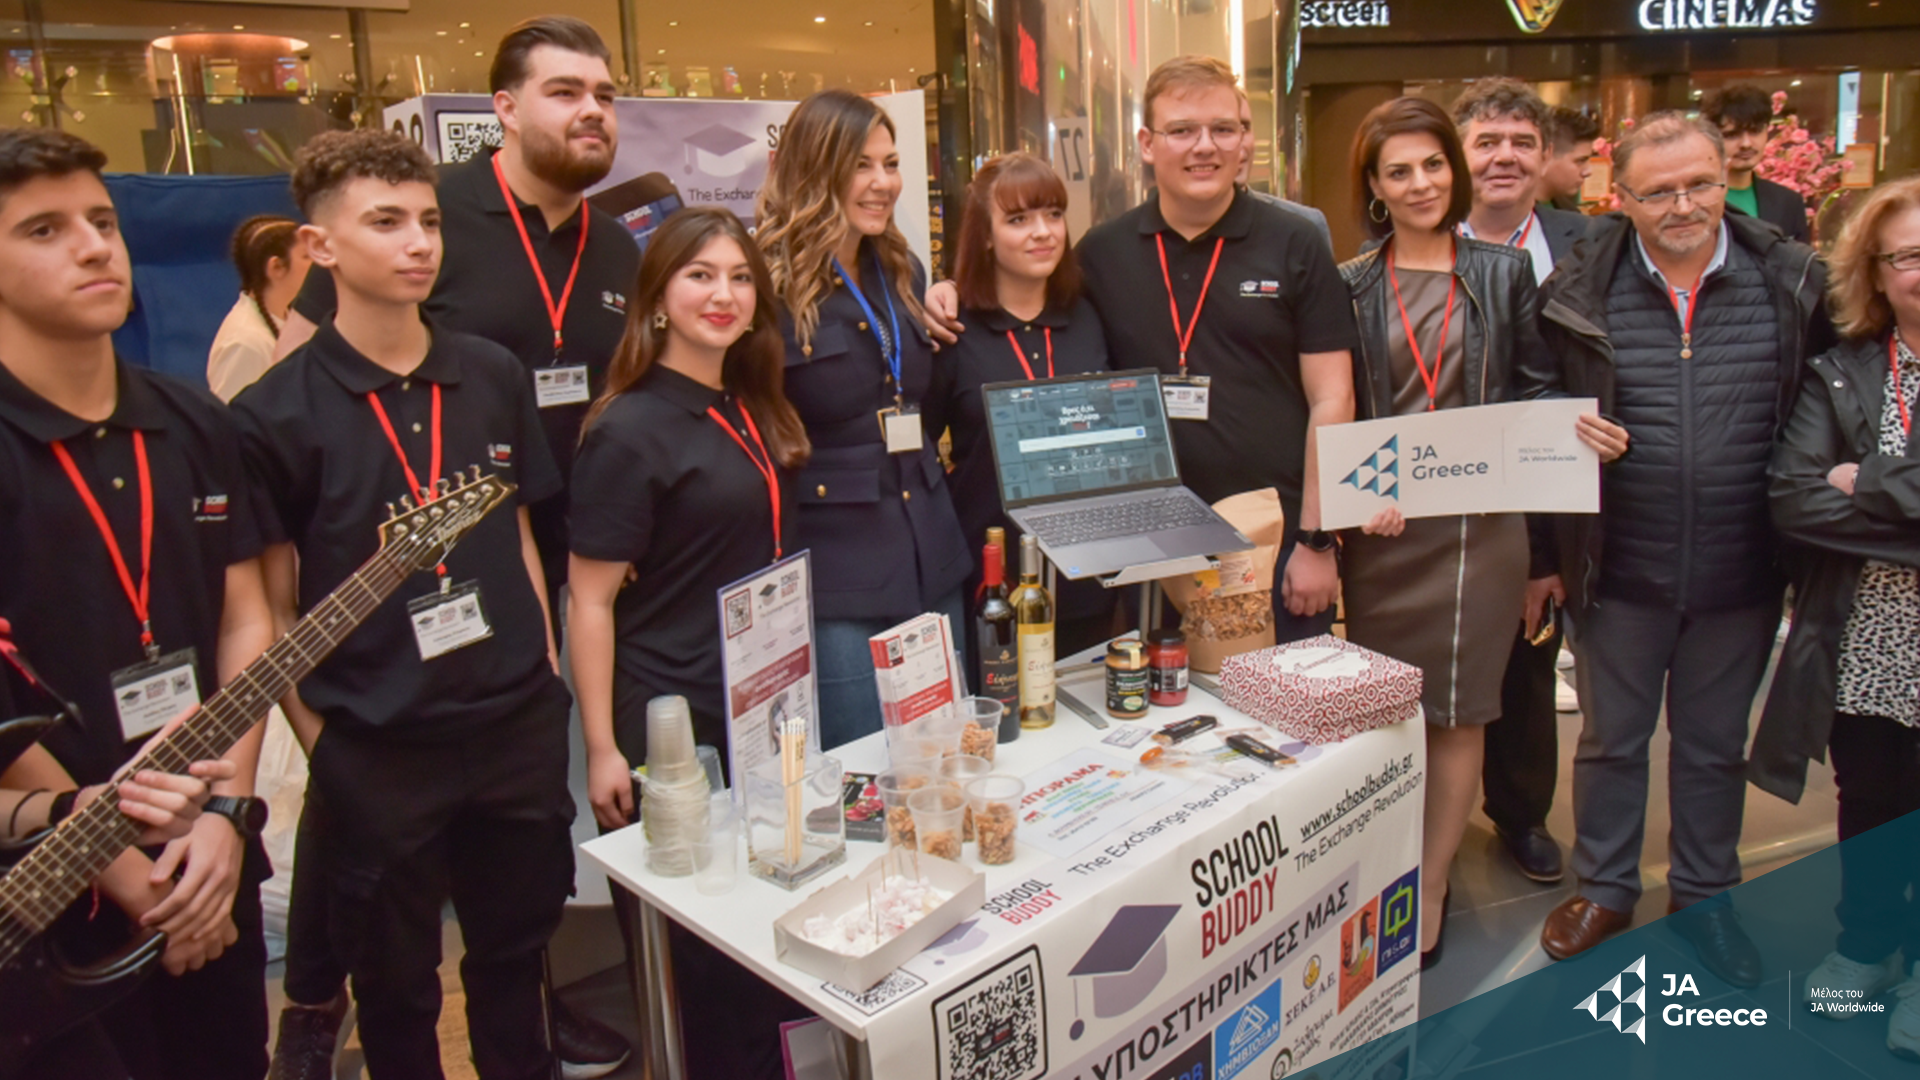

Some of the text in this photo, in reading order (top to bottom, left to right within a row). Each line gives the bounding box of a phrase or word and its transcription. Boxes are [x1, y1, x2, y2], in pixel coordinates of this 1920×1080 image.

[1299, 1, 1391, 27] screen
[1638, 0, 1818, 30] CINEMAS
[688, 187, 758, 202] The Exchan
[1411, 445, 1438, 462] JA
[1412, 461, 1489, 480] Greece
[1299, 752, 1414, 842] www.schoolbuddy.gr
[1294, 771, 1423, 872] The Exchange Revolution
[1067, 855, 1113, 877] The
[1104, 807, 1191, 858] Exchange
[1190, 814, 1290, 907] SCHOOL
[981, 878, 1053, 915] SCHOOL
[999, 888, 1062, 926] BUDDY
[1201, 866, 1278, 959] BUDDY
[1091, 920, 1300, 1080] ΥΠΟΣΤΗΡΙΚΤΕΣ
[1303, 880, 1349, 940] ΜΑΣ
